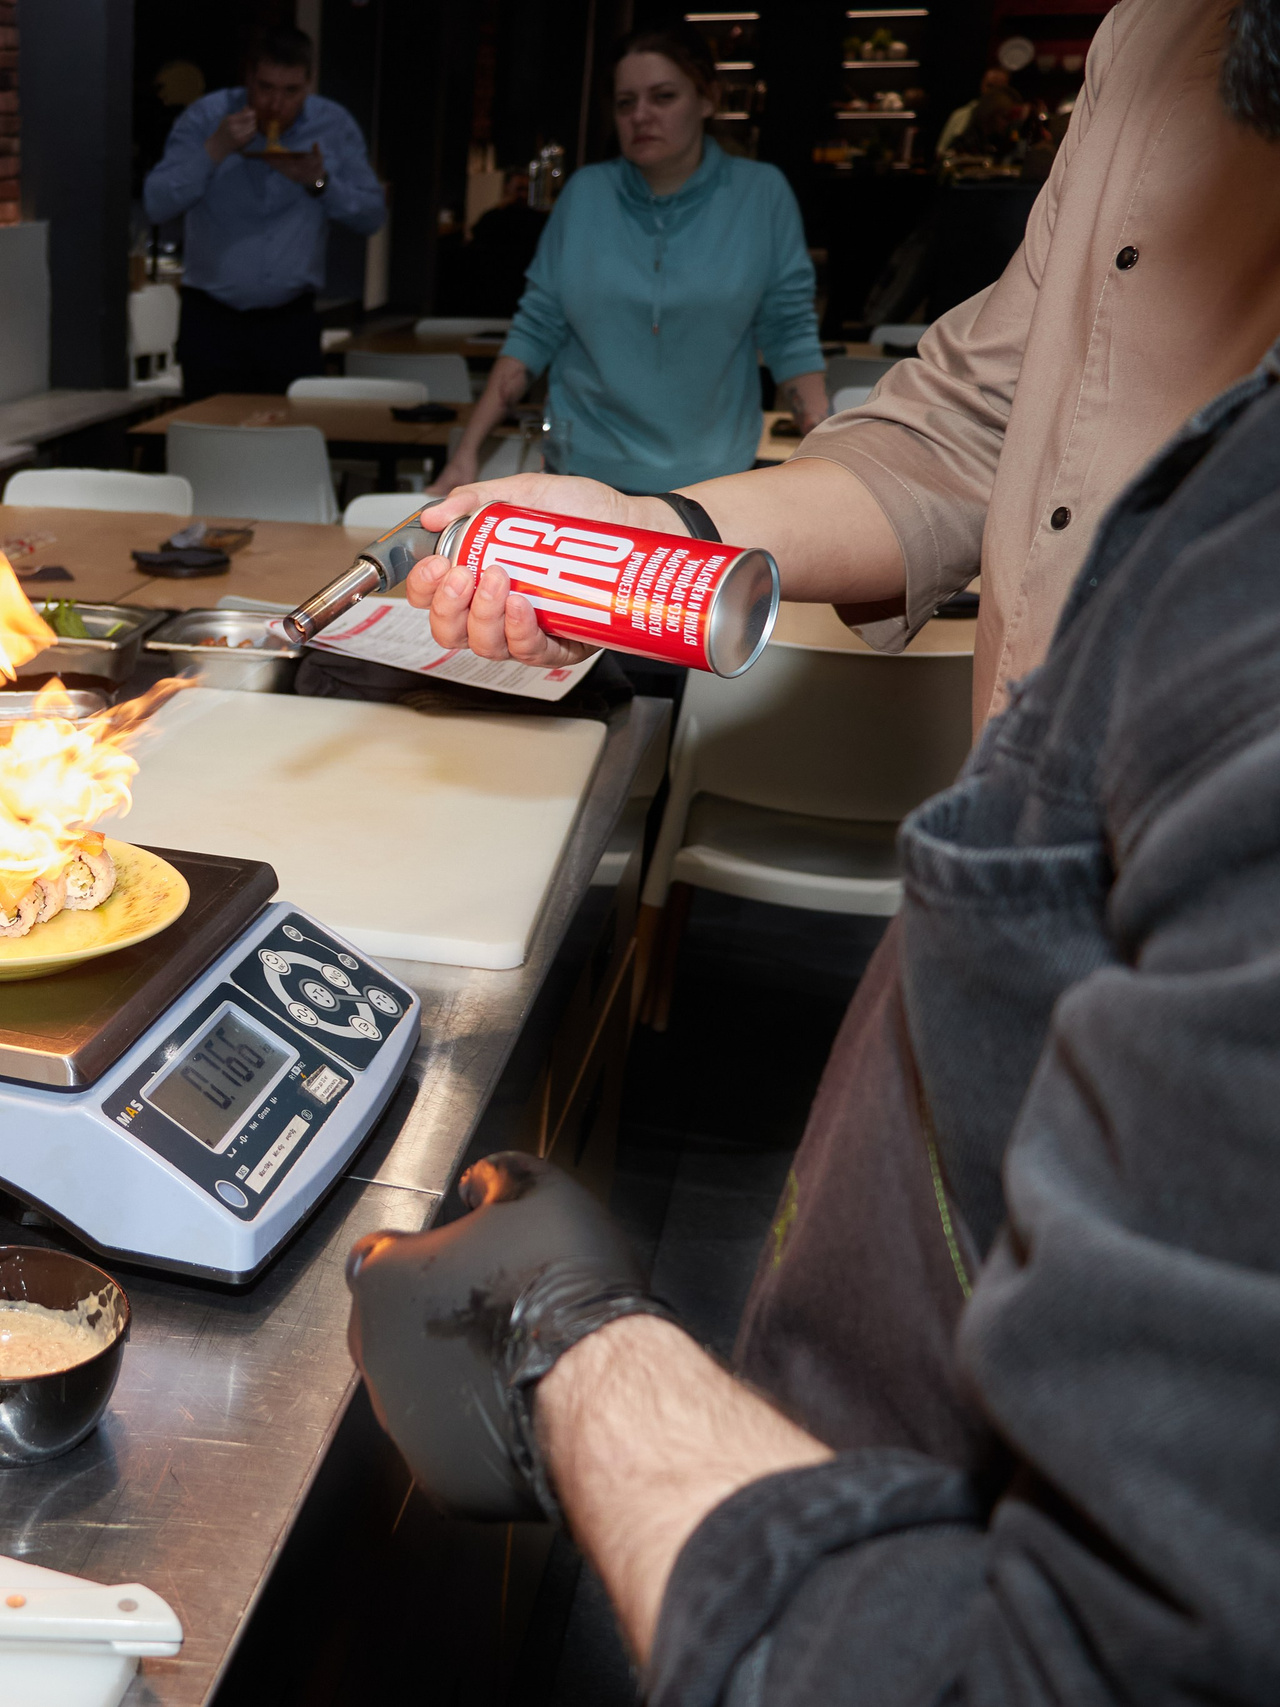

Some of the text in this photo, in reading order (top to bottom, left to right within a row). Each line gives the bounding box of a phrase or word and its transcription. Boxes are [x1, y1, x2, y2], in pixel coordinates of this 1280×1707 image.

[467, 516, 500, 589] ВЕРСАЛЬНЫЙ
[481, 517, 635, 626] ГАЗ
[614, 551, 648, 616] ВСЕСЕЗОННЫЙ
[631, 546, 672, 631] ДЛЯ ПОРТАТИВНЫХ
[648, 548, 691, 637] ГАЗОВЫХ ПРИБОРОВ
[665, 558, 705, 633] СМЕСЬ ПРОПАНА,
[683, 555, 728, 647] БУТАНА И ИЗОБУТАНА
[116, 1099, 144, 1127] MAS
[257, 1106, 271, 1120] Gross
